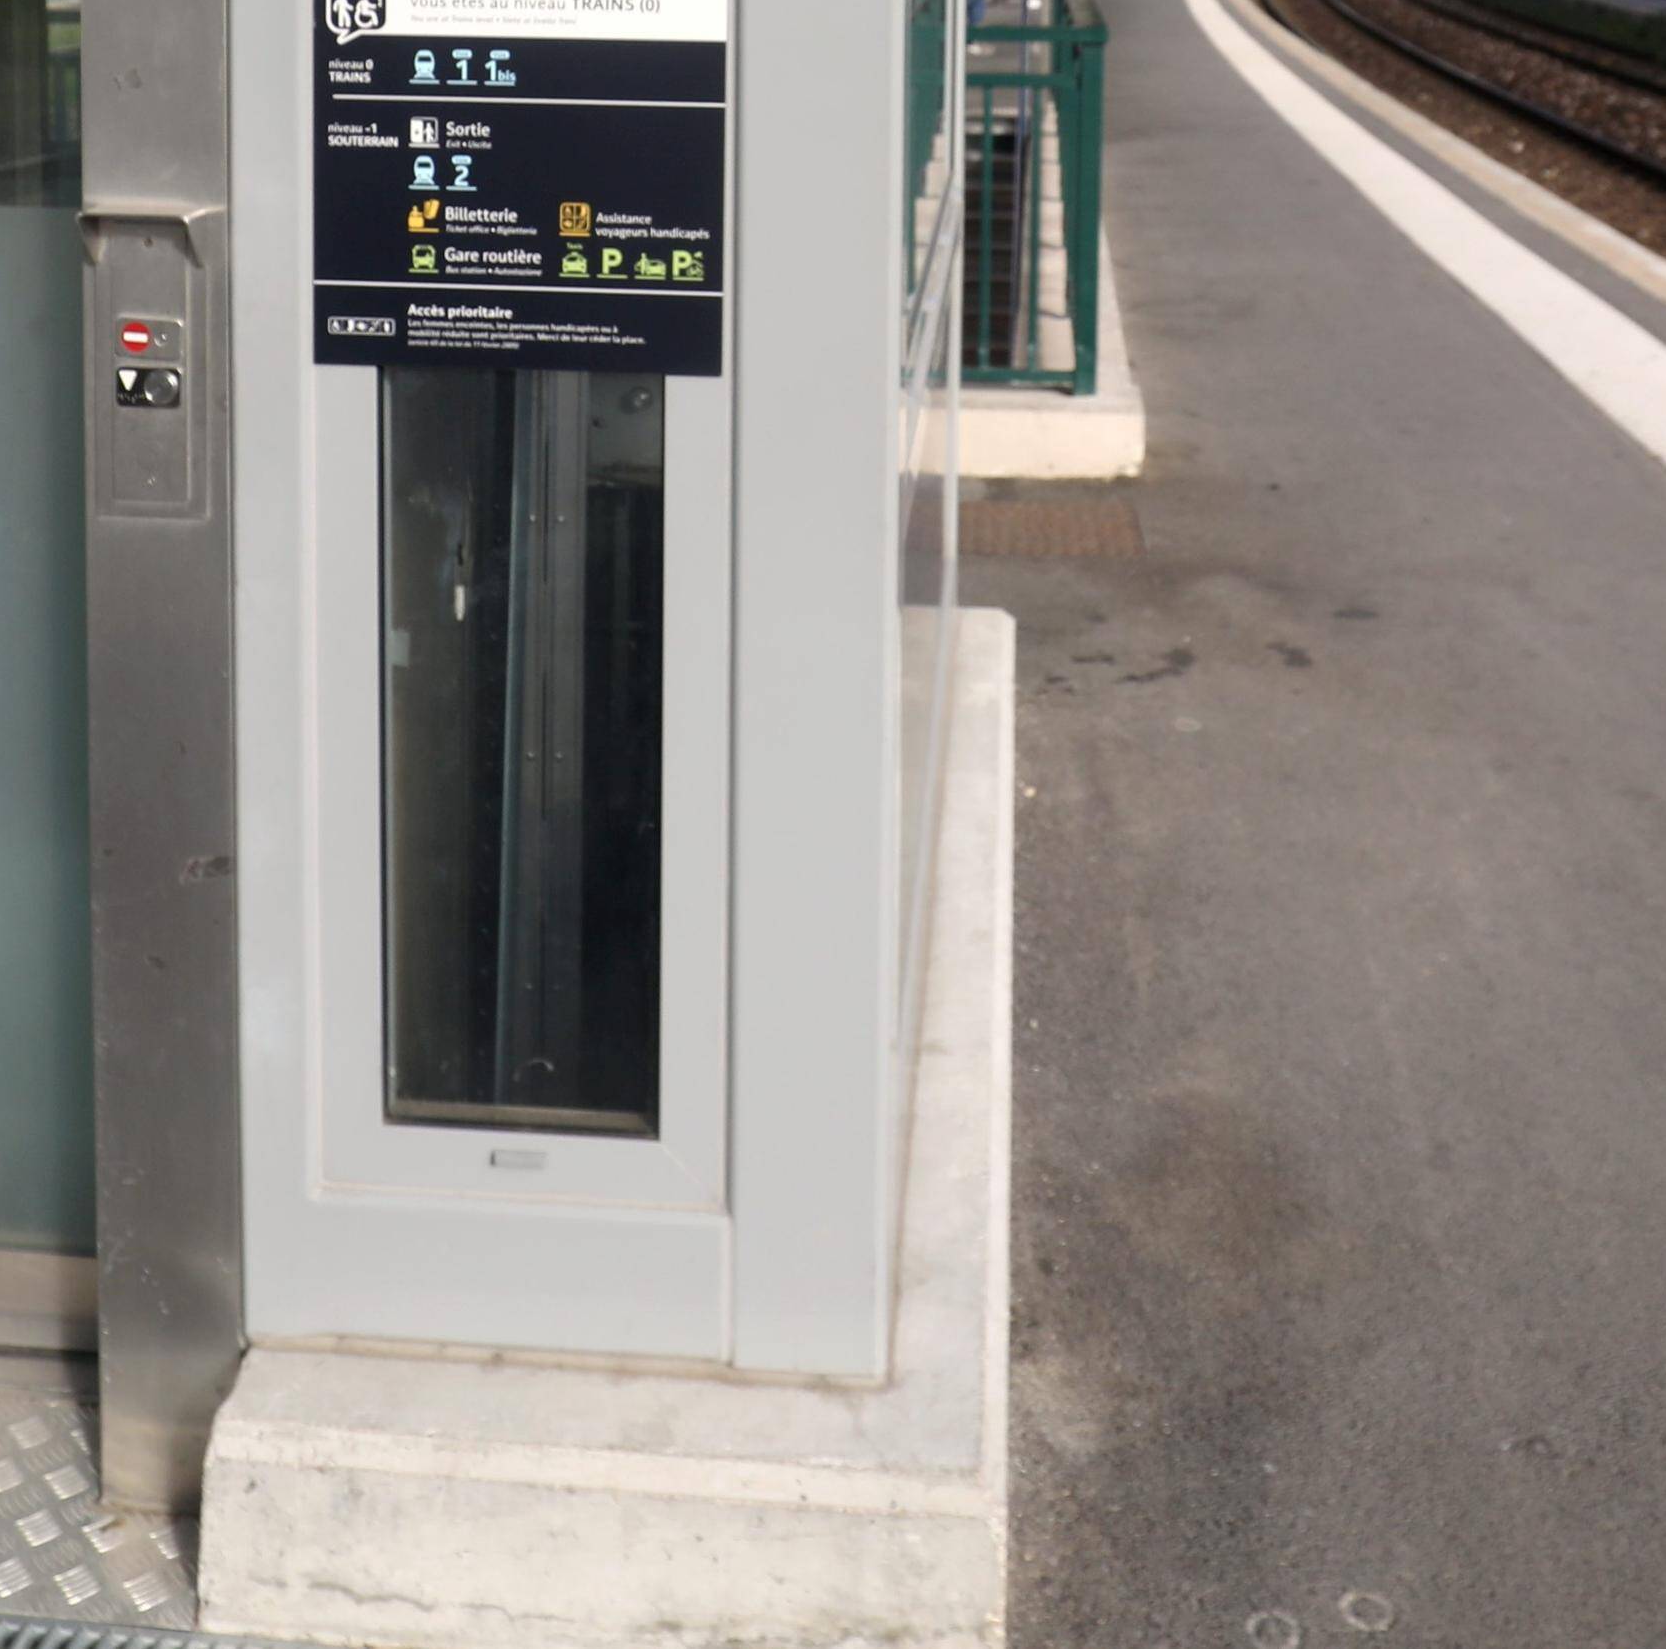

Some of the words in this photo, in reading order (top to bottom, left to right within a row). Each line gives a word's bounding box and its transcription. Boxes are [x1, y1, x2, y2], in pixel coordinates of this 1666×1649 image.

[328, 58, 364, 70] niveau
[365, 58, 374, 70] 0
[456, 59, 469, 81] 1
[484, 59, 517, 82] 1bis
[328, 71, 372, 83] TRAINS
[328, 122, 363, 134] niveau
[365, 122, 378, 134] -1
[446, 121, 491, 138] Sortie
[327, 135, 399, 148] SOUTERRAIN
[453, 166, 471, 187] 2
[445, 206, 518, 224] Billetterie
[595, 212, 653, 225] Assistance
[595, 227, 649, 240] voyageurs
[650, 227, 711, 242] handicapés
[444, 246, 480, 263] Gare
[483, 248, 542, 265] routière
[601, 247, 623, 275] P
[407, 303, 446, 318] Accès
[448, 306, 513, 321] prioritaire
